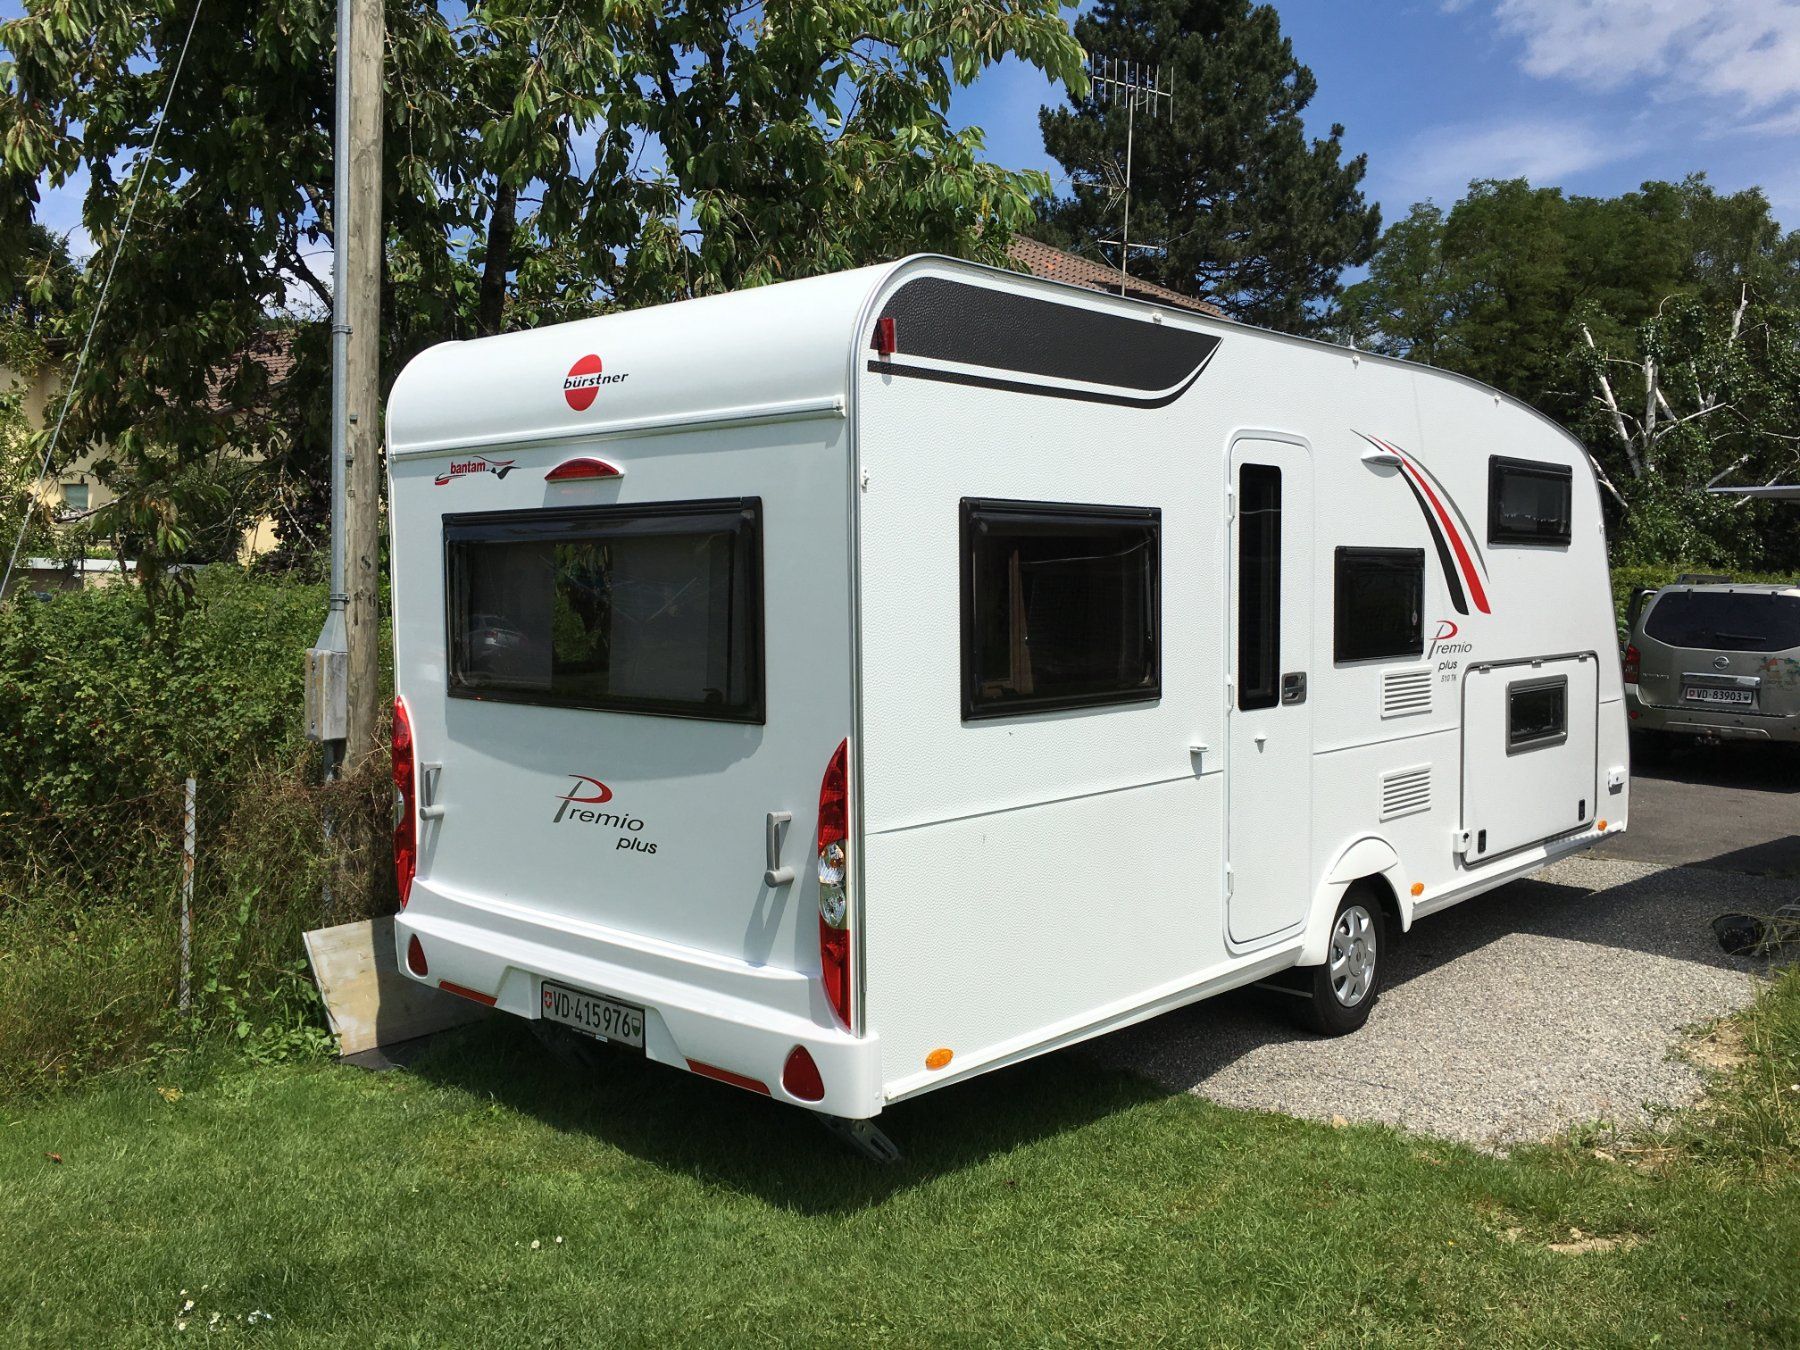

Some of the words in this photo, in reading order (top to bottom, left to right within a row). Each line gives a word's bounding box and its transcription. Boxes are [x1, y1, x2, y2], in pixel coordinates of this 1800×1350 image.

[563, 373, 629, 390] bürstner
[450, 460, 486, 475] bantam
[1428, 620, 1472, 659] Premio
[1438, 660, 1457, 672] plus
[553, 774, 644, 831] Premio
[616, 837, 658, 855] plus
